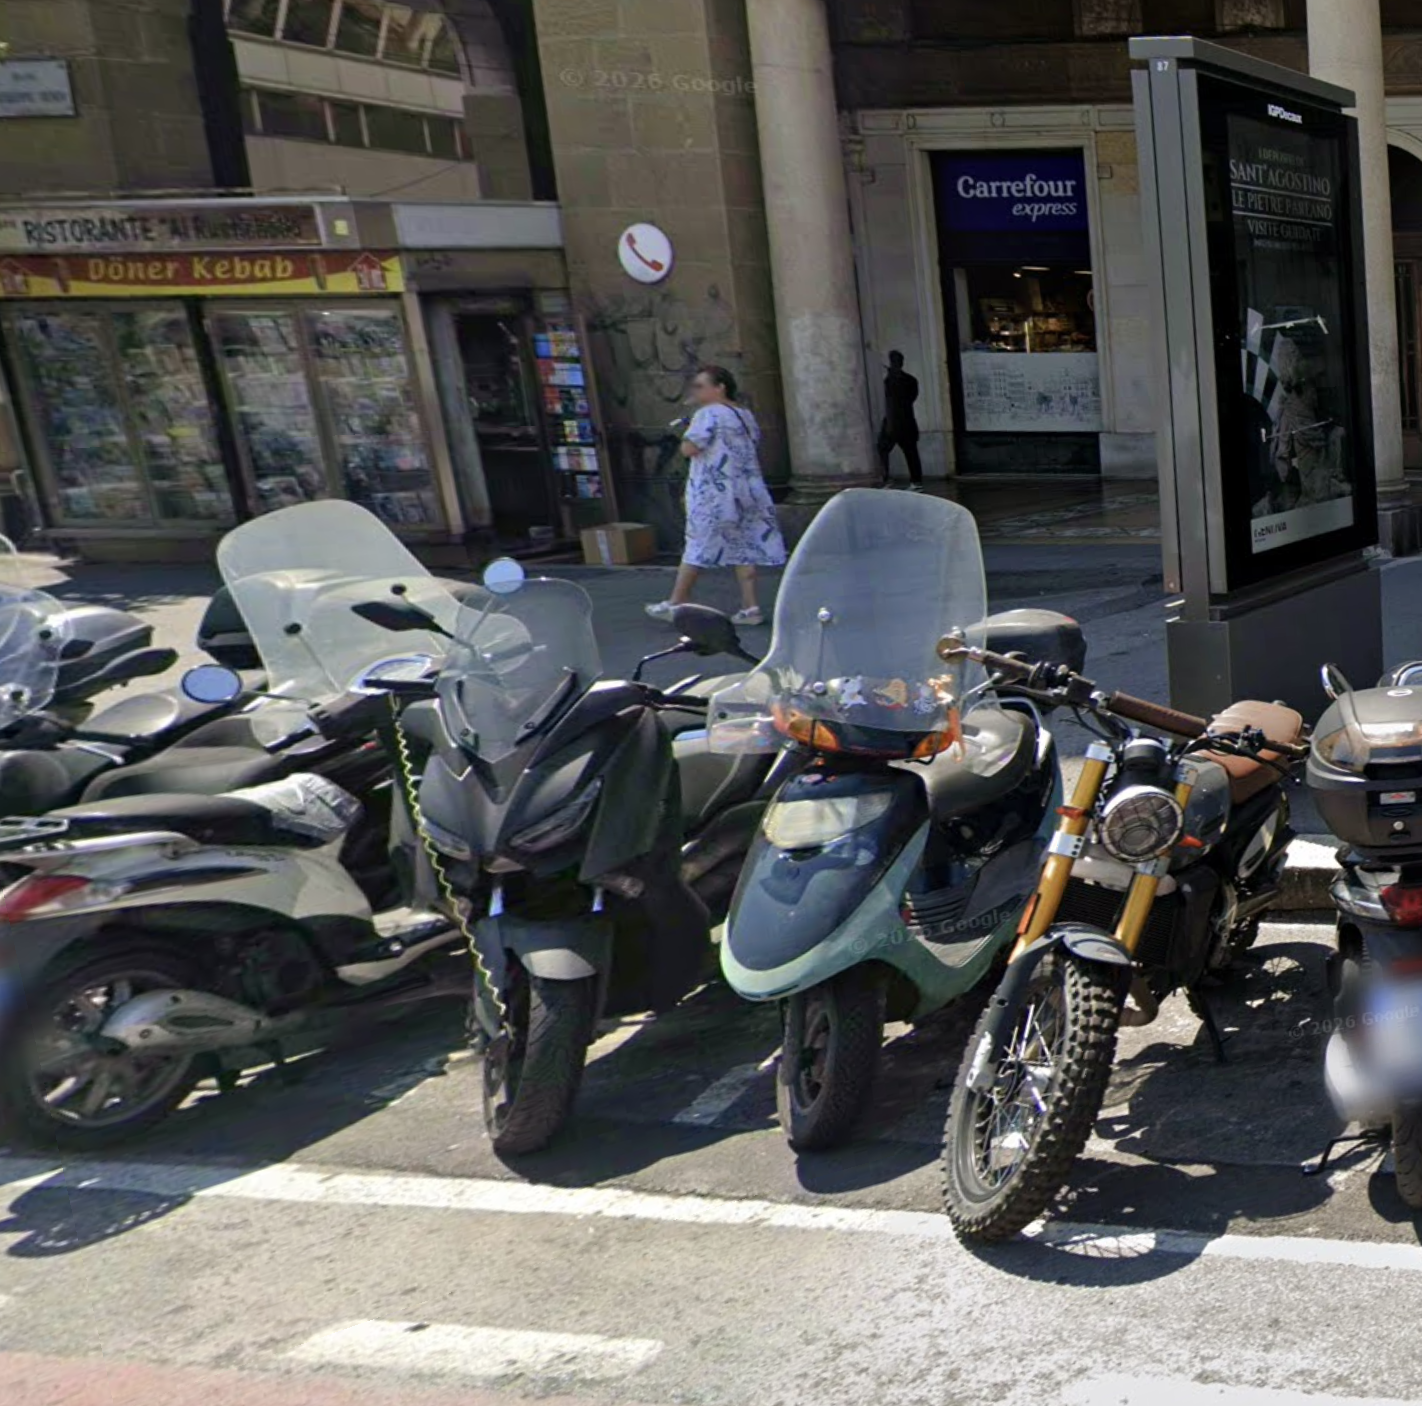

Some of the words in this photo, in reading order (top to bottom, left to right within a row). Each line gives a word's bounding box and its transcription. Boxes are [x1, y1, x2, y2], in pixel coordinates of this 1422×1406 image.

[957, 173, 1076, 198] Carrefour
[1229, 158, 1330, 195] SANT'AGOSTINO
[1232, 189, 1245, 208] LE
[1012, 202, 1077, 222] express
[24, 216, 155, 243] RISTORANTE
[88, 257, 183, 280] Döner
[192, 257, 293, 278] Kebab
